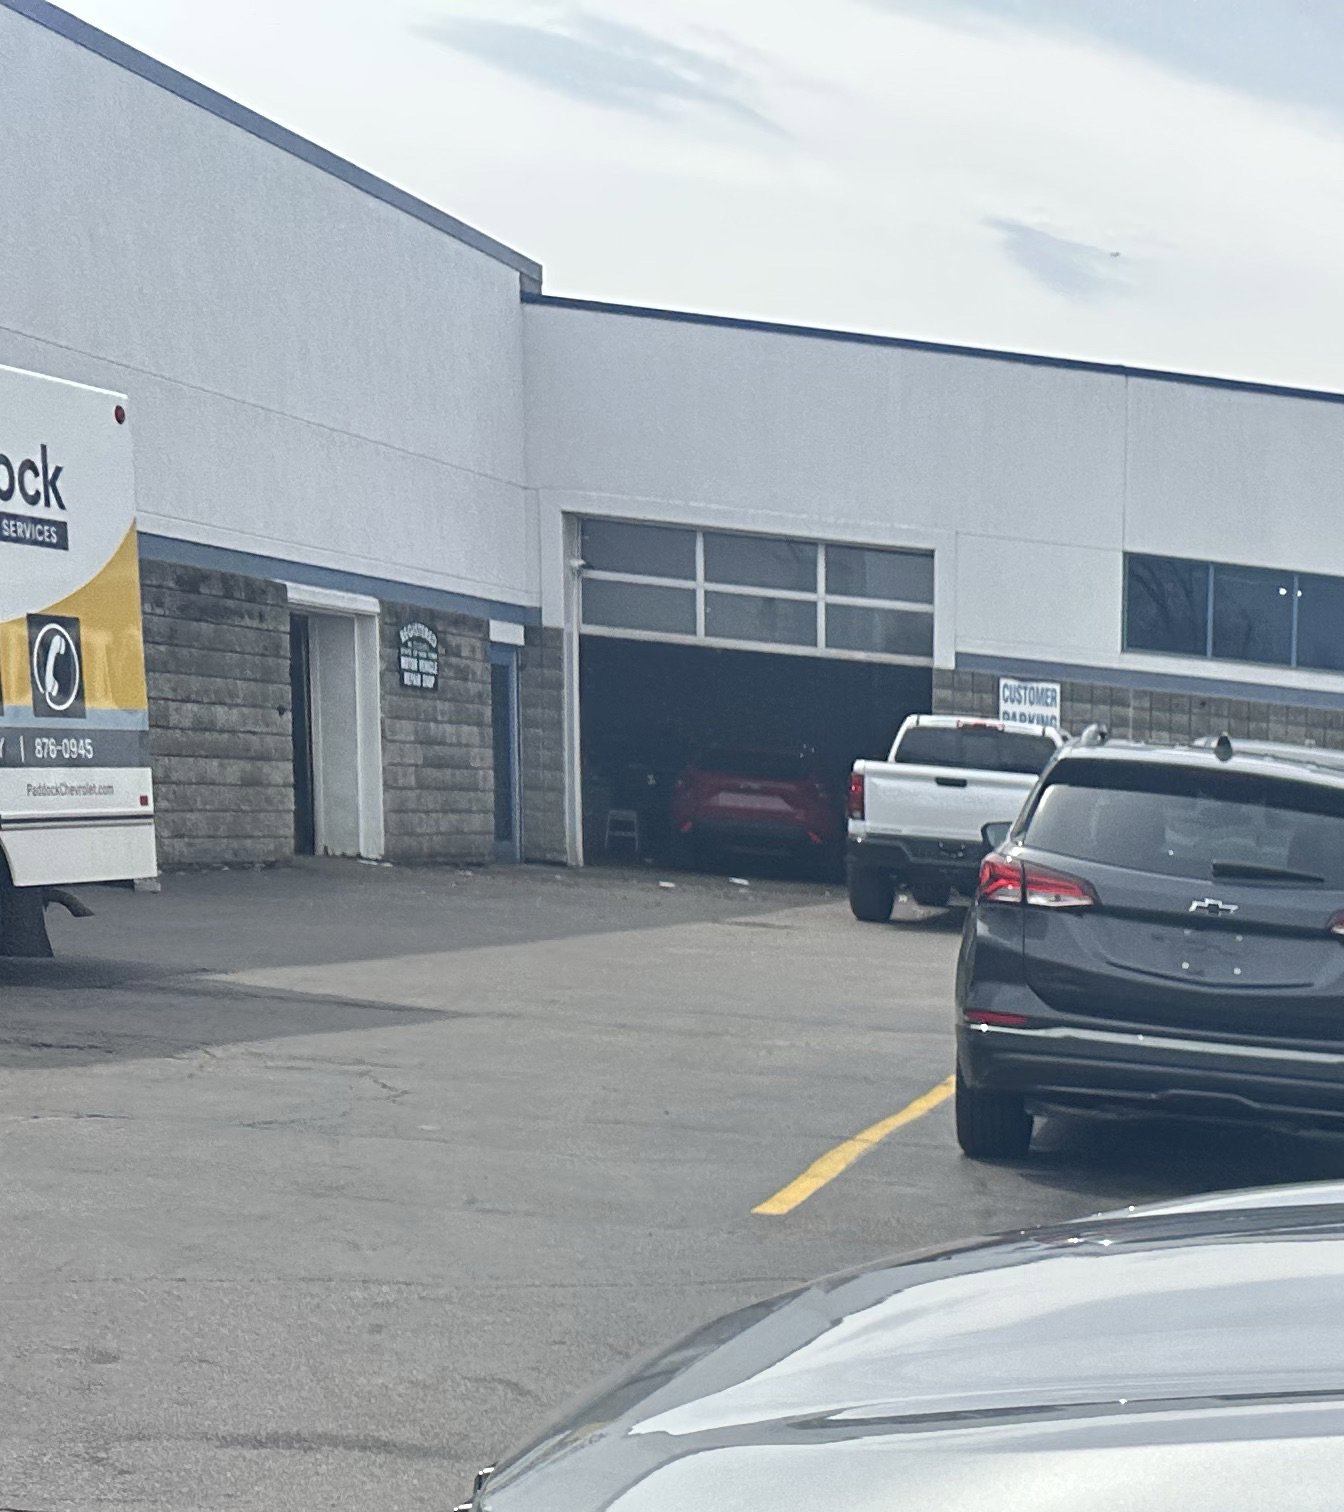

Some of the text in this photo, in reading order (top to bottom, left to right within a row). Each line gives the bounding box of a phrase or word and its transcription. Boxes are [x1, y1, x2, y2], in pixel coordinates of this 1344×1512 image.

[2, 519, 58, 543] SERVICES
[1002, 683, 1057, 707] CUSTOMER
[34, 737, 94, 759] 876-0945
